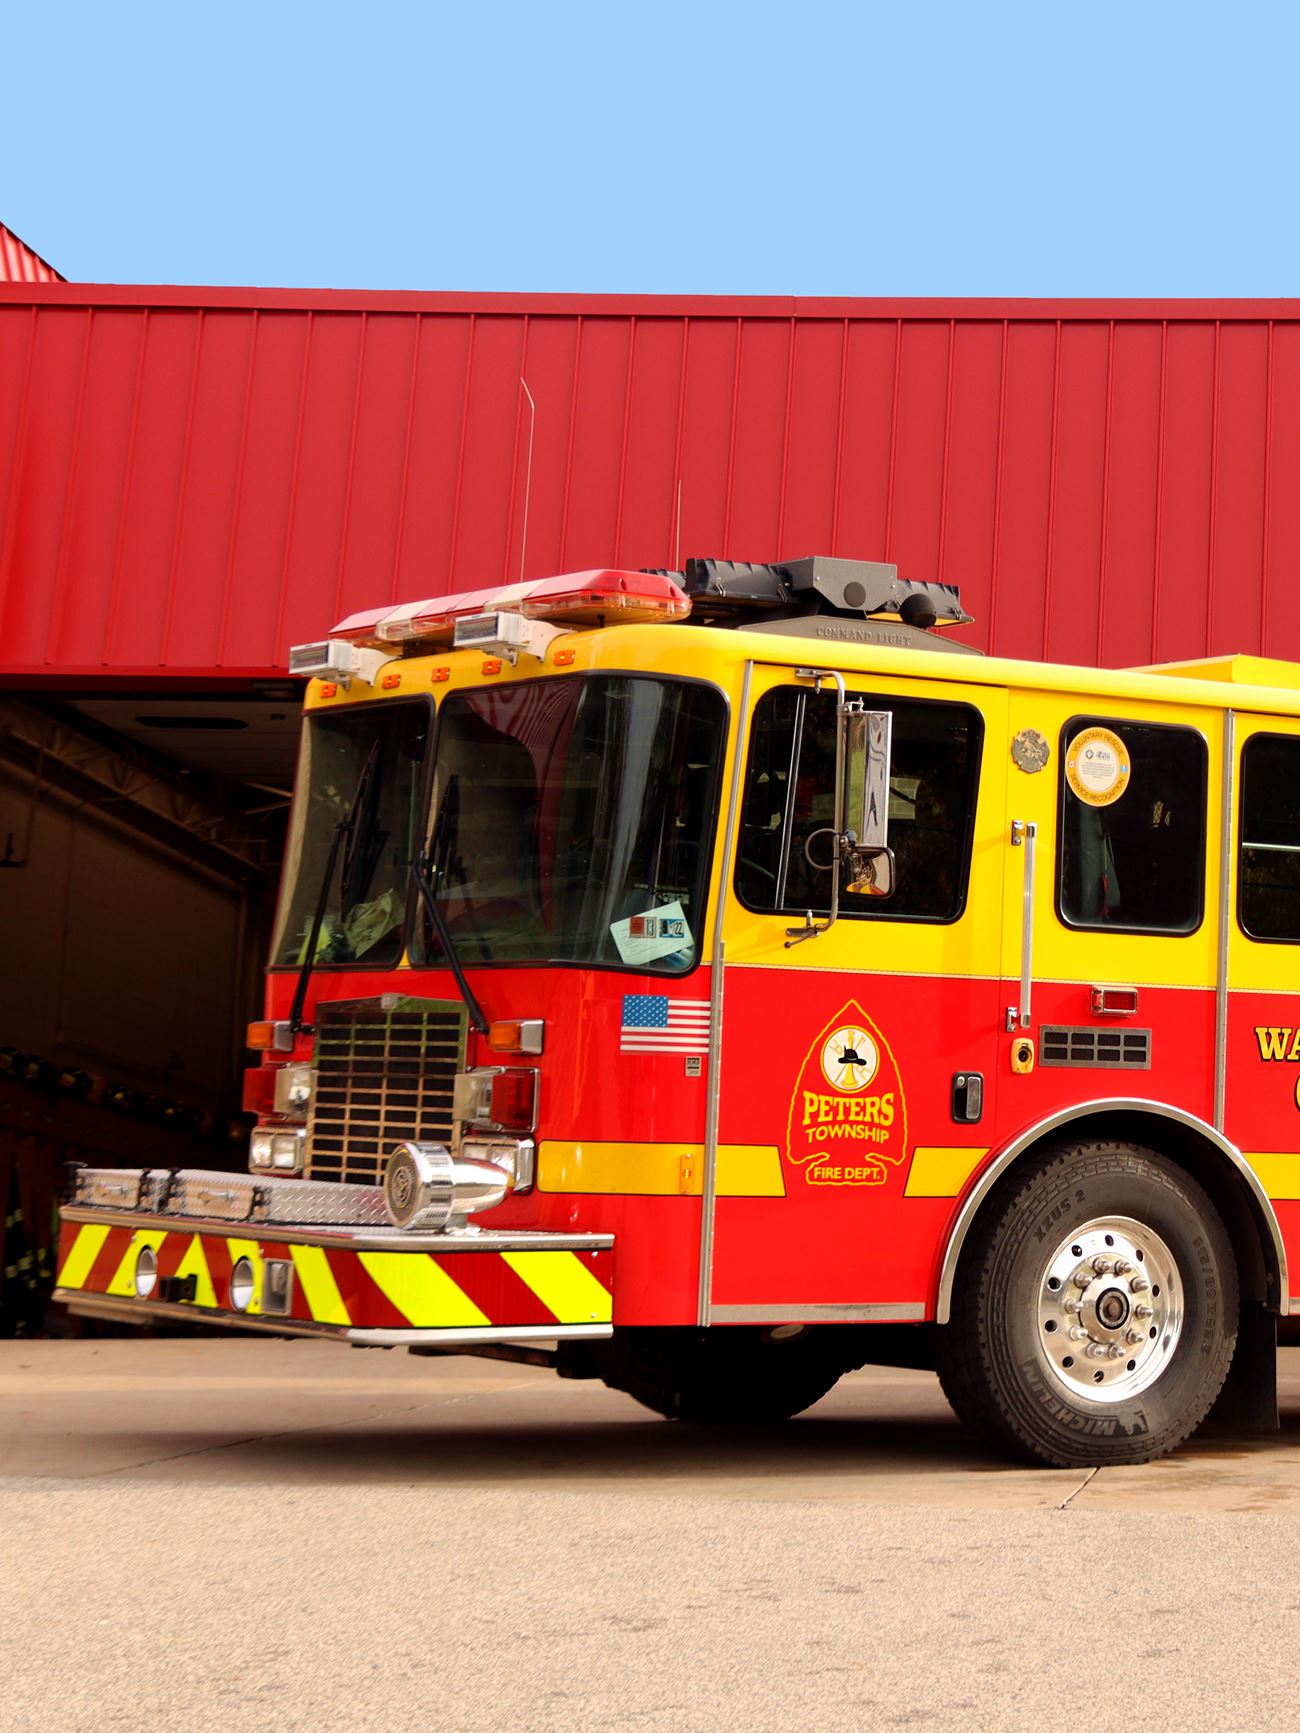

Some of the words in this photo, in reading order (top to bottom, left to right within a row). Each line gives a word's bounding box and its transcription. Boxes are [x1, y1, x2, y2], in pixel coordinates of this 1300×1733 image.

[815, 626, 871, 641] COMMAND
[876, 631, 912, 646] LIGHT
[802, 1090, 894, 1127] PETERS
[805, 1124, 890, 1144] TOWNSHIP
[813, 1167, 842, 1180] FIRE
[844, 1167, 881, 1180] DEPT.
[1019, 1357, 1118, 1437] MICHELIN
